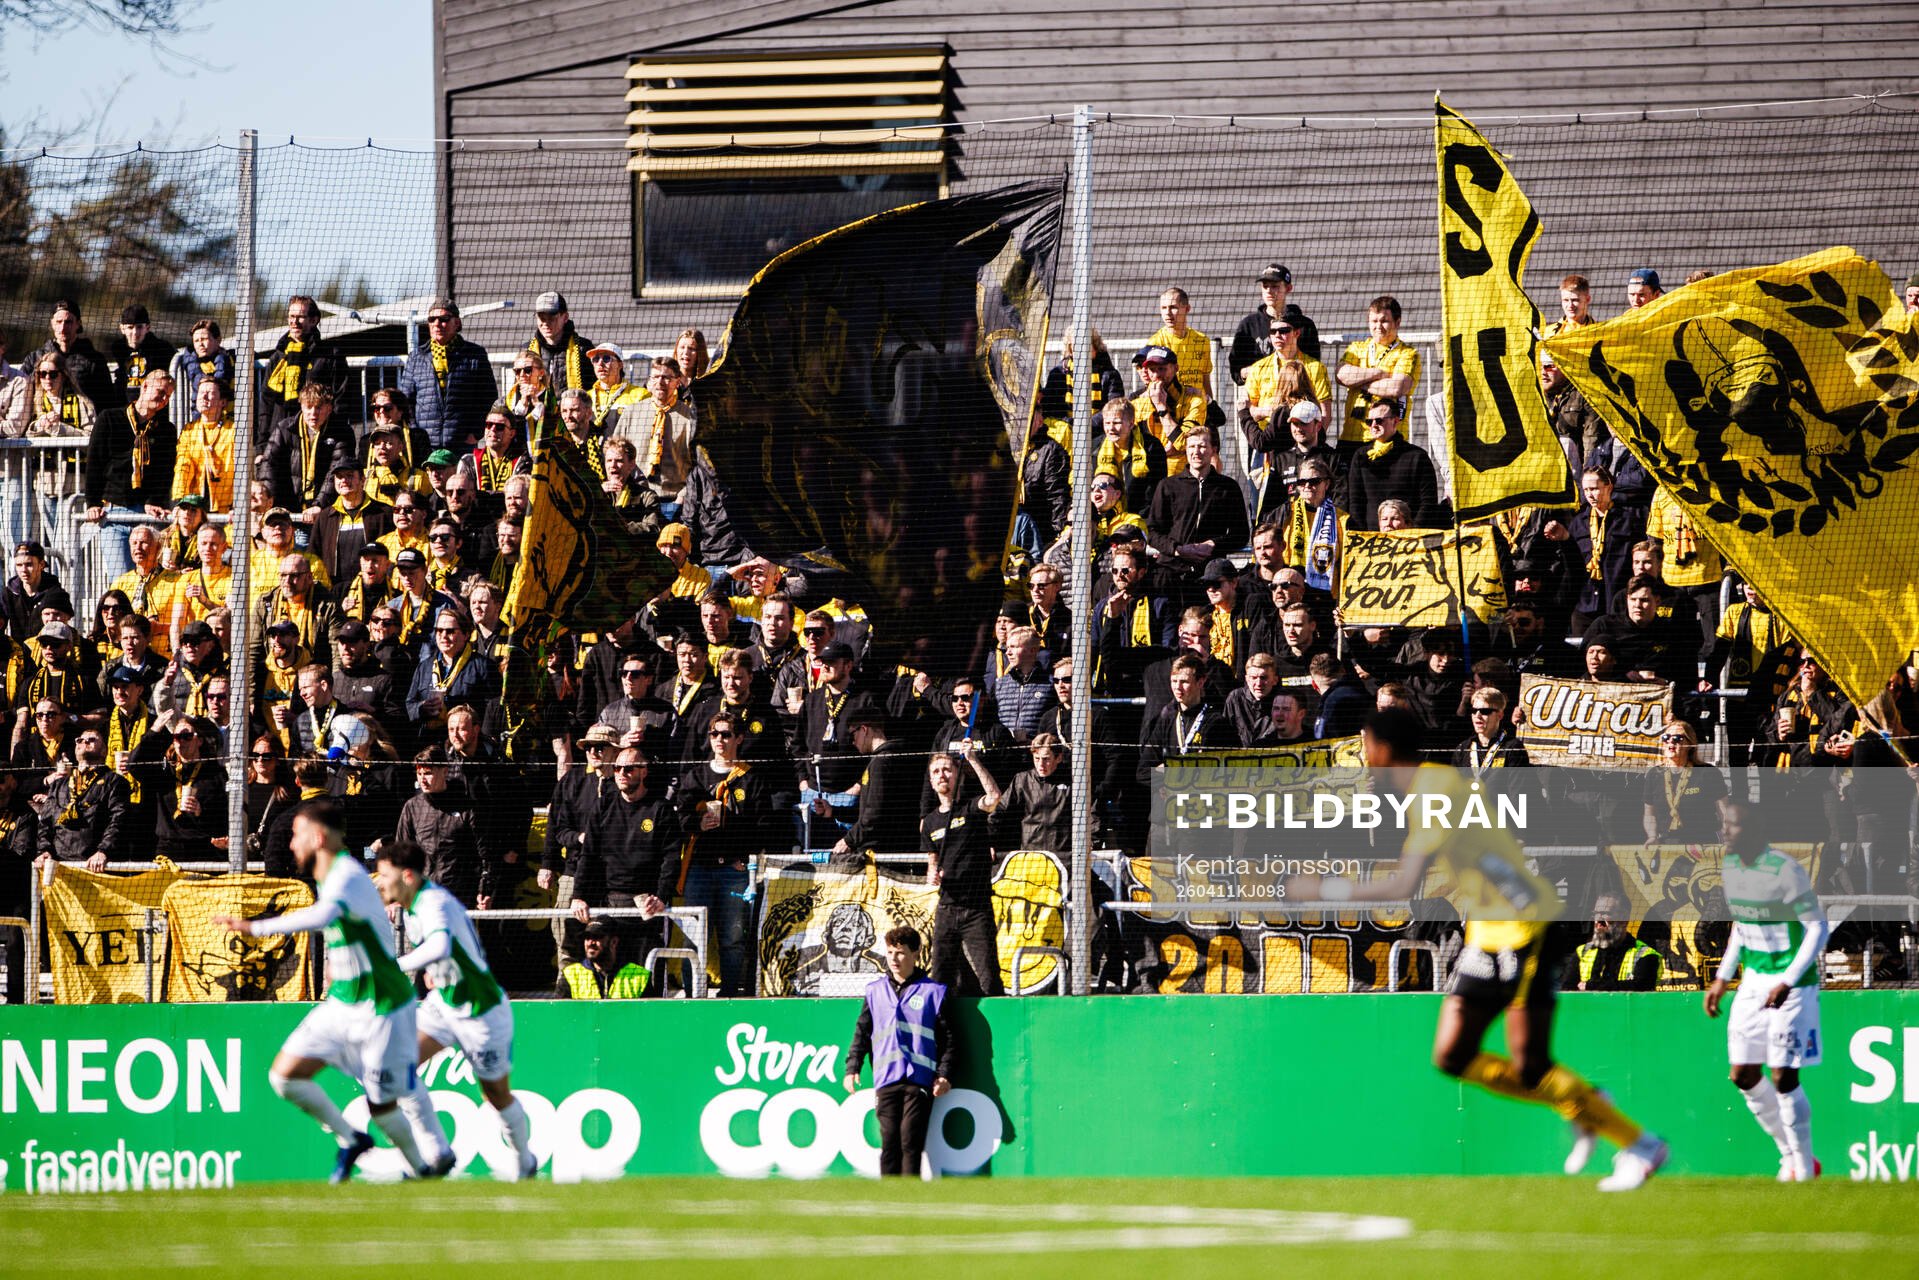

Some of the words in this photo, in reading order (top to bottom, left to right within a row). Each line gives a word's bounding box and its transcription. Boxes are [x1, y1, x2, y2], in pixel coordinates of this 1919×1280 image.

[1344, 534, 1420, 558] PABLO
[1344, 557, 1356, 580] I
[1358, 558, 1424, 583] LOVE
[1524, 684, 1668, 737] Ultras
[1164, 737, 1366, 790] ULTRAS
[1568, 734, 1616, 757] 2018
[2, 1037, 242, 1114] NEON
[714, 1022, 840, 1086] Stora
[1849, 1025, 1919, 1104] S
[1849, 1130, 1919, 1182] sky
